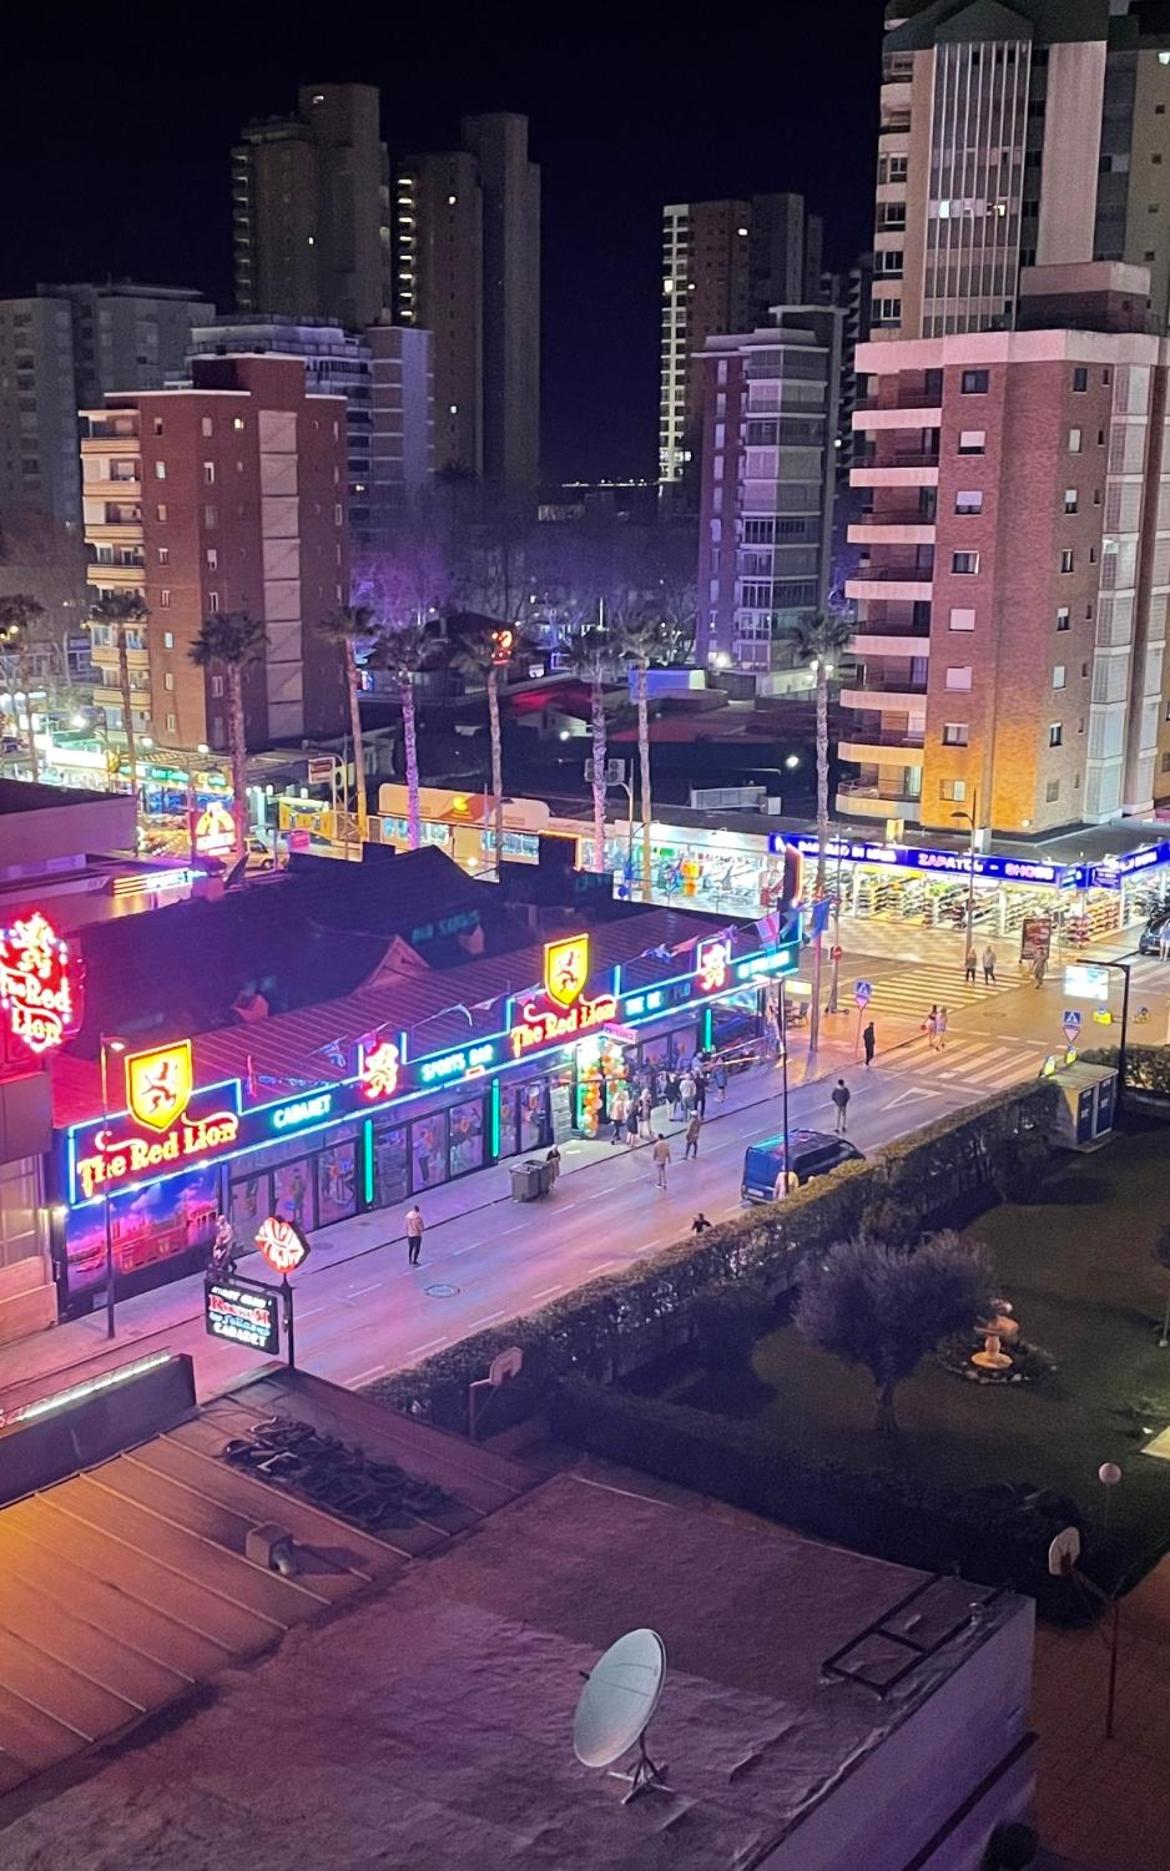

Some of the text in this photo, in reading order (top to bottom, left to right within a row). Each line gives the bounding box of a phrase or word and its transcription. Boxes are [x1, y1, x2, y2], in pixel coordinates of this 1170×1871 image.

[510, 1024, 543, 1058] The
[537, 1007, 578, 1040] Red
[579, 994, 616, 1029] Lion
[77, 1112, 238, 1198] The Red Lion
